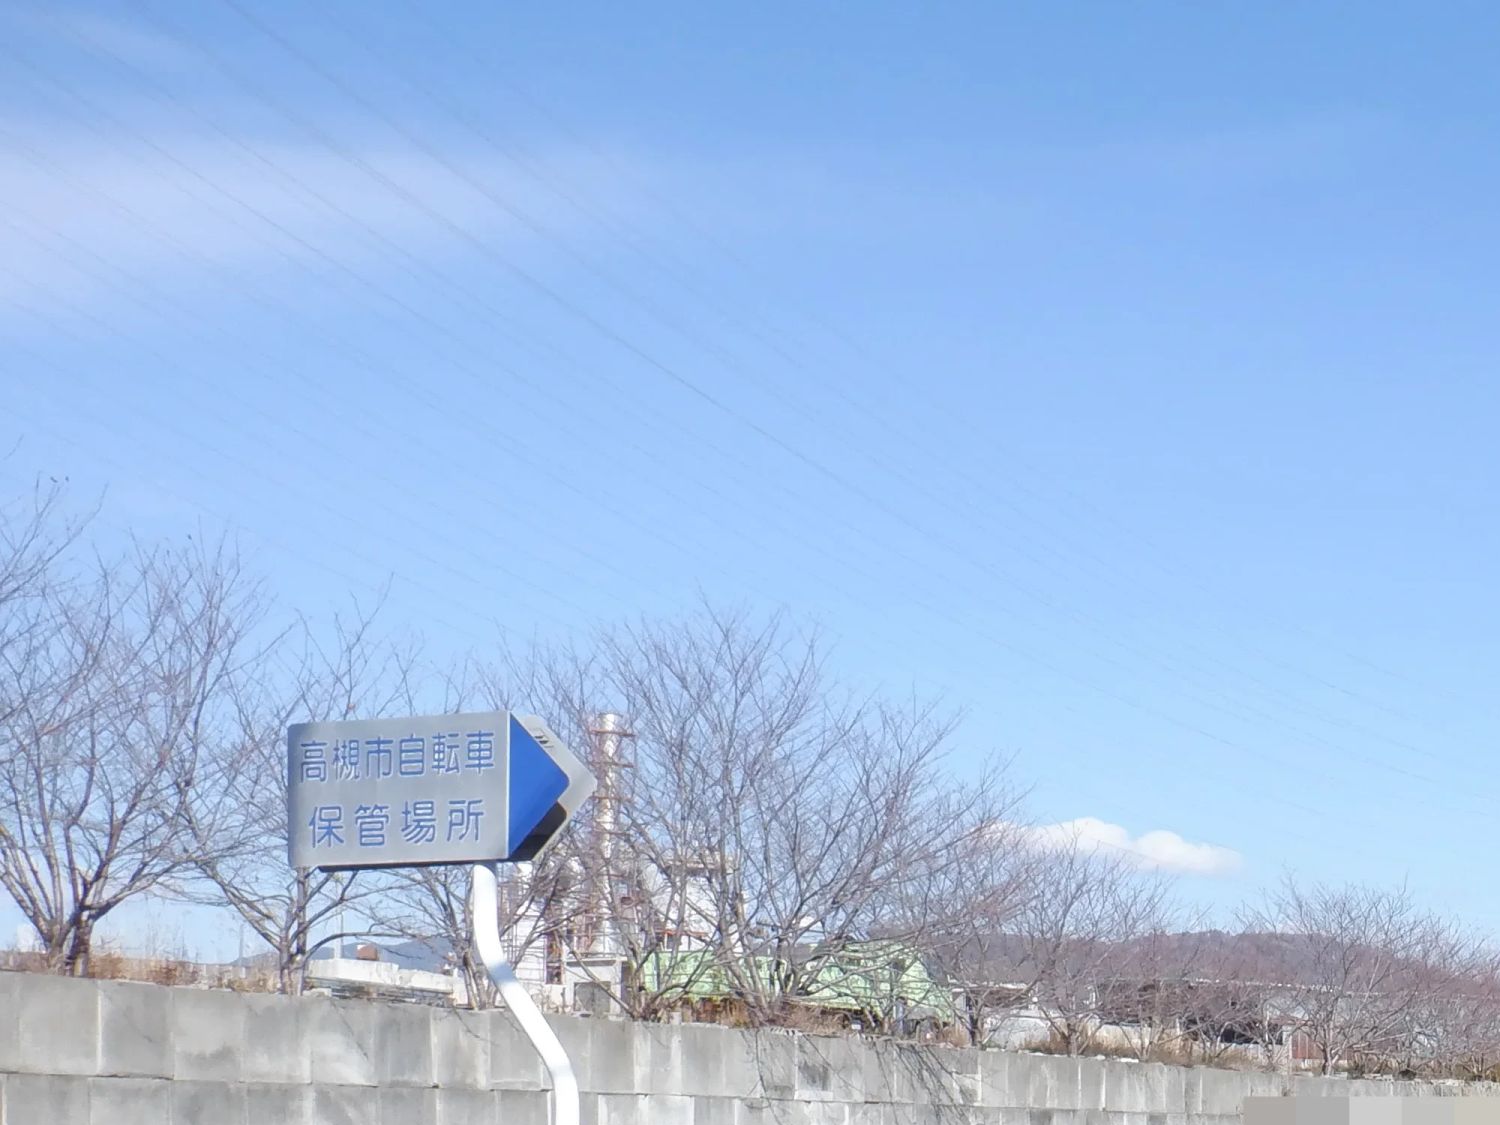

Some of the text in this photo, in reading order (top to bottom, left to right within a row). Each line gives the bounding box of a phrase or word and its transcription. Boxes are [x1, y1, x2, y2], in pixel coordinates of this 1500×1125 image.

[299, 729, 496, 784] 高槻市自転車
[307, 798, 486, 849] 保管場所
